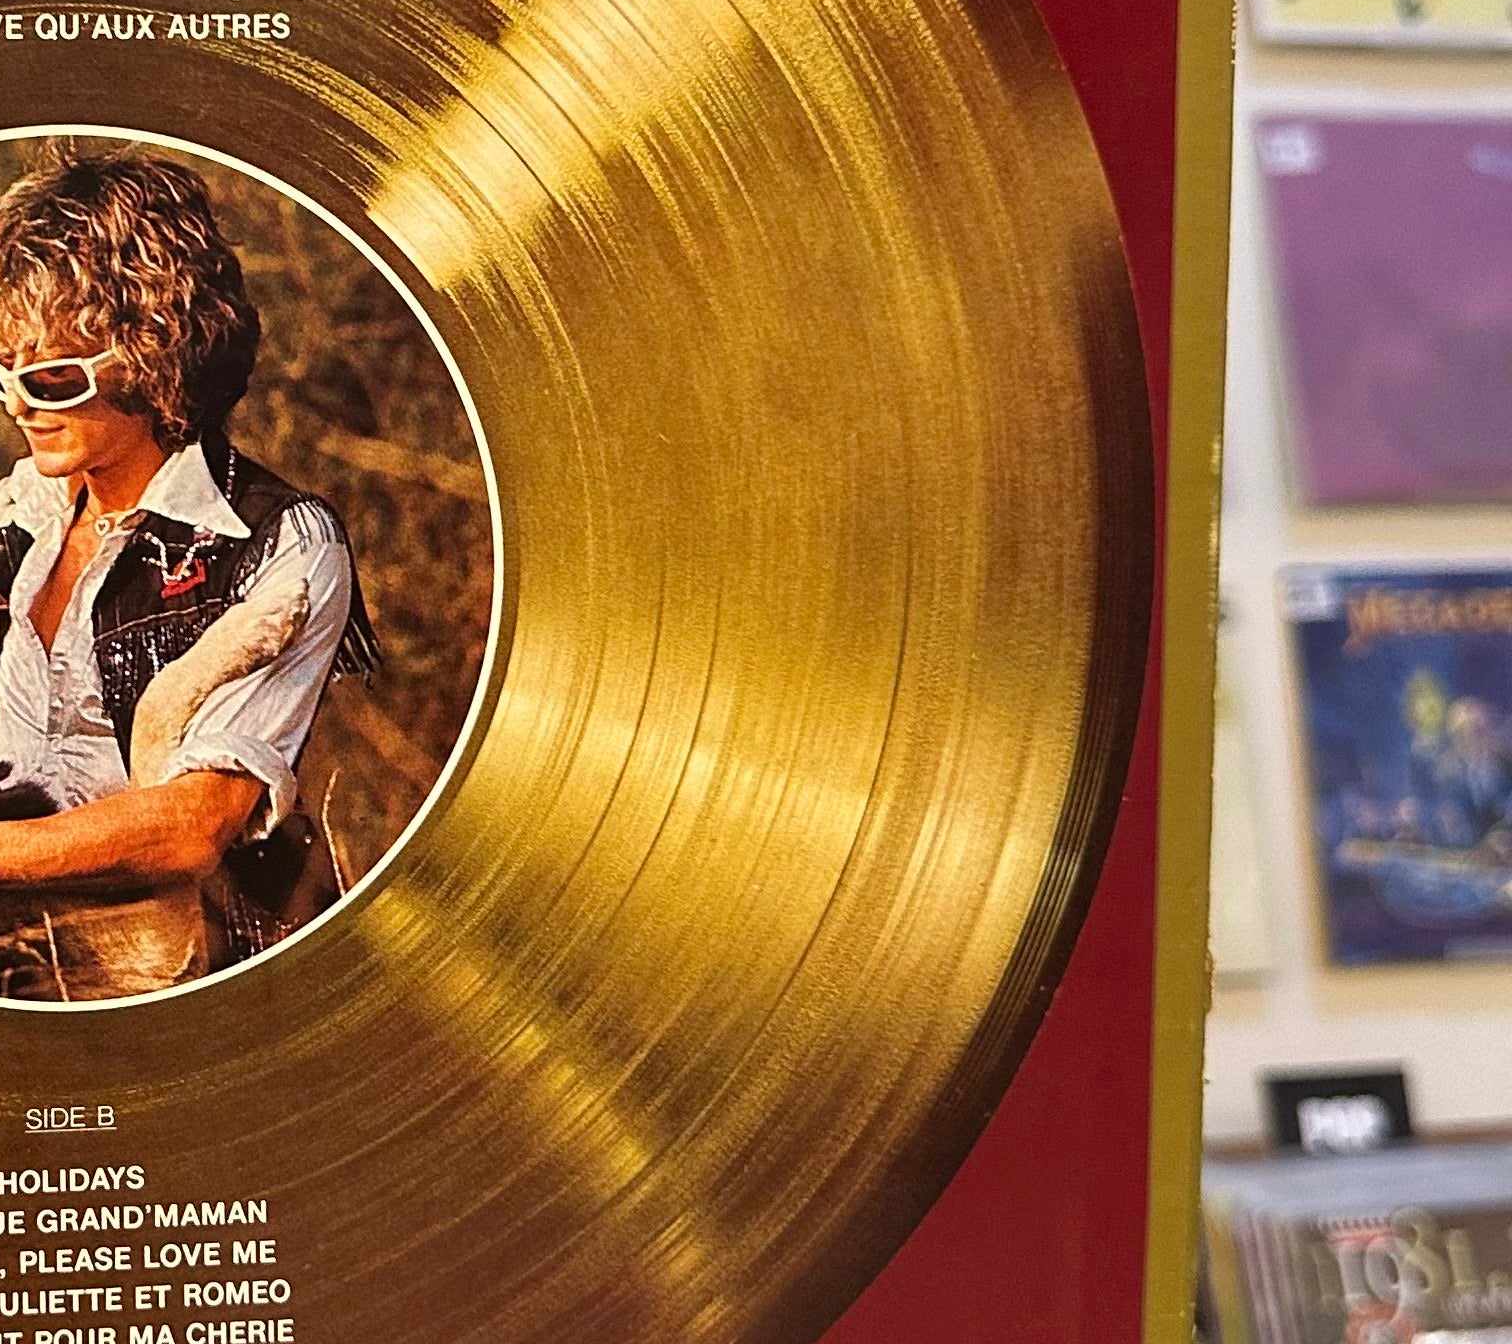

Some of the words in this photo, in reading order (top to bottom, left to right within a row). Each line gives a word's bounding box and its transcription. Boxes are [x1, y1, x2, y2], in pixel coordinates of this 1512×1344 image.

[34, 12, 156, 41] QU'AUX
[167, 12, 291, 41] AUTRES
[25, 1106, 88, 1130] SIDE
[97, 1105, 115, 1126] B
[36, 1199, 267, 1234] GRAND'MAMAN
[19, 1246, 132, 1274] PLEASE
[143, 1242, 221, 1269] LOVE
[232, 1239, 277, 1265] ME
[135, 1284, 172, 1310] ET
[183, 1278, 291, 1308] ROMEO
